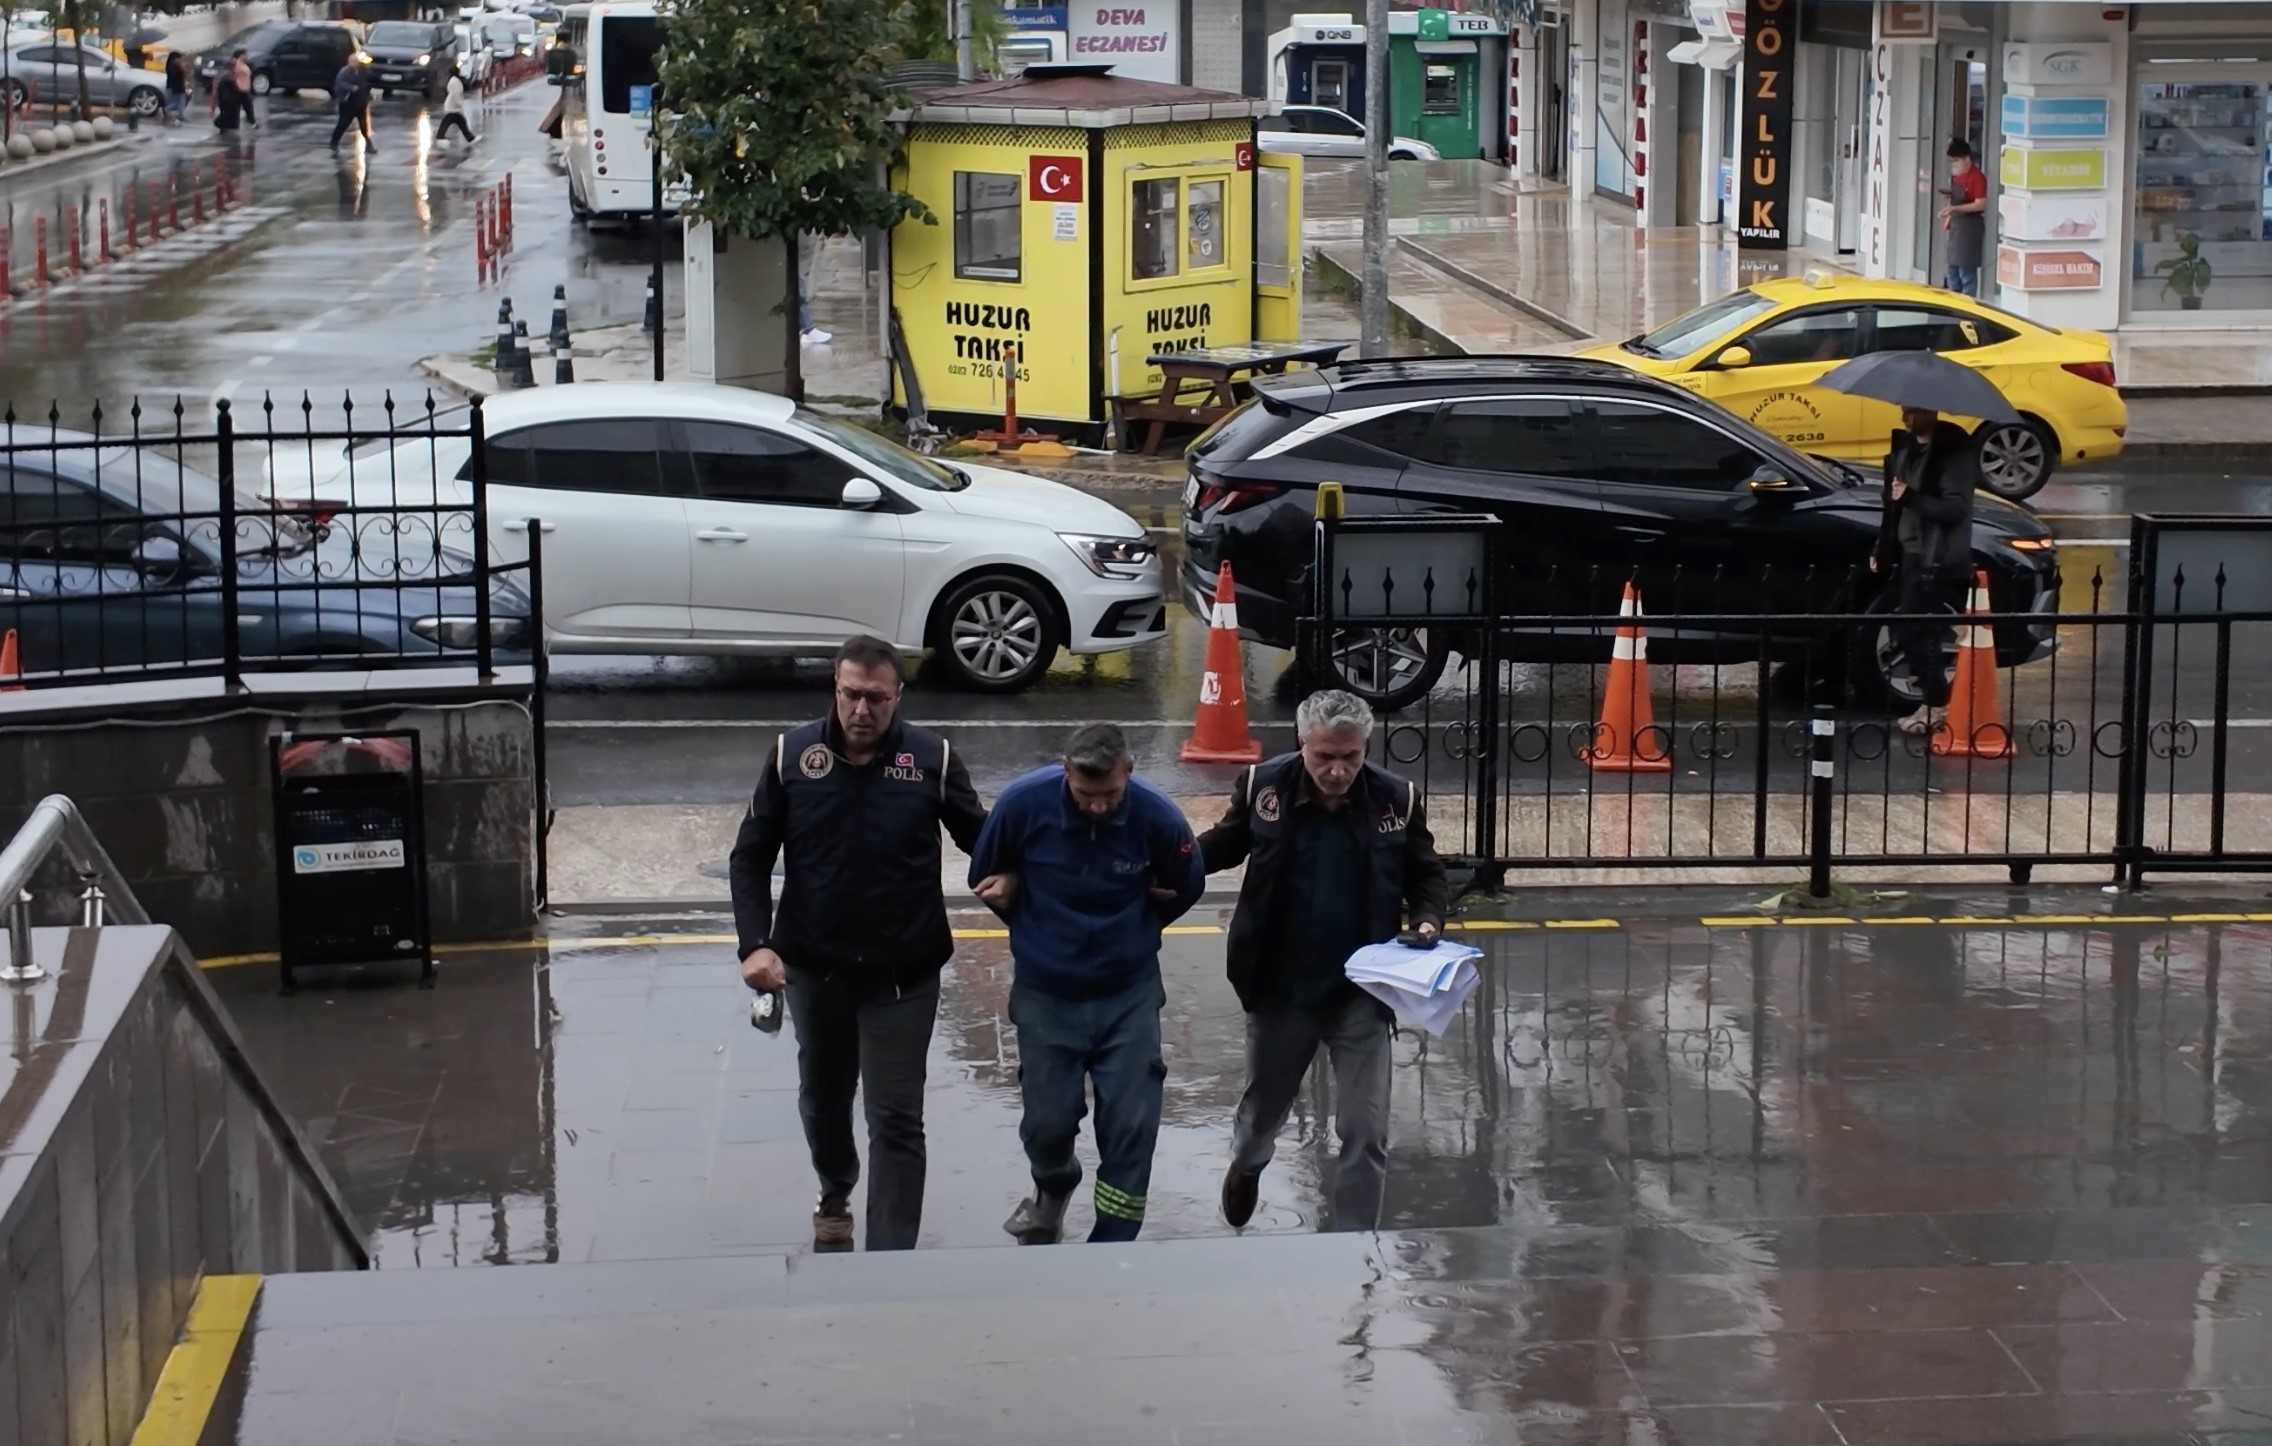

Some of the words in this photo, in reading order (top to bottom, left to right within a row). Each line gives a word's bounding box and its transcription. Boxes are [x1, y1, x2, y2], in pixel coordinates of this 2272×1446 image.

[1096, 9, 1146, 26] DEVA
[1457, 19, 1489, 31] TEB
[1075, 31, 1168, 53] ECZANESİ
[1327, 30, 1352, 40] QNB
[1740, 227, 1780, 239] YAPILIR
[946, 301, 1031, 332] HUZUR
[1147, 303, 1211, 334] HUZUR
[971, 363, 993, 379] 726
[1750, 392, 1785, 422] HUZUR
[1786, 432, 1825, 442] 2638
